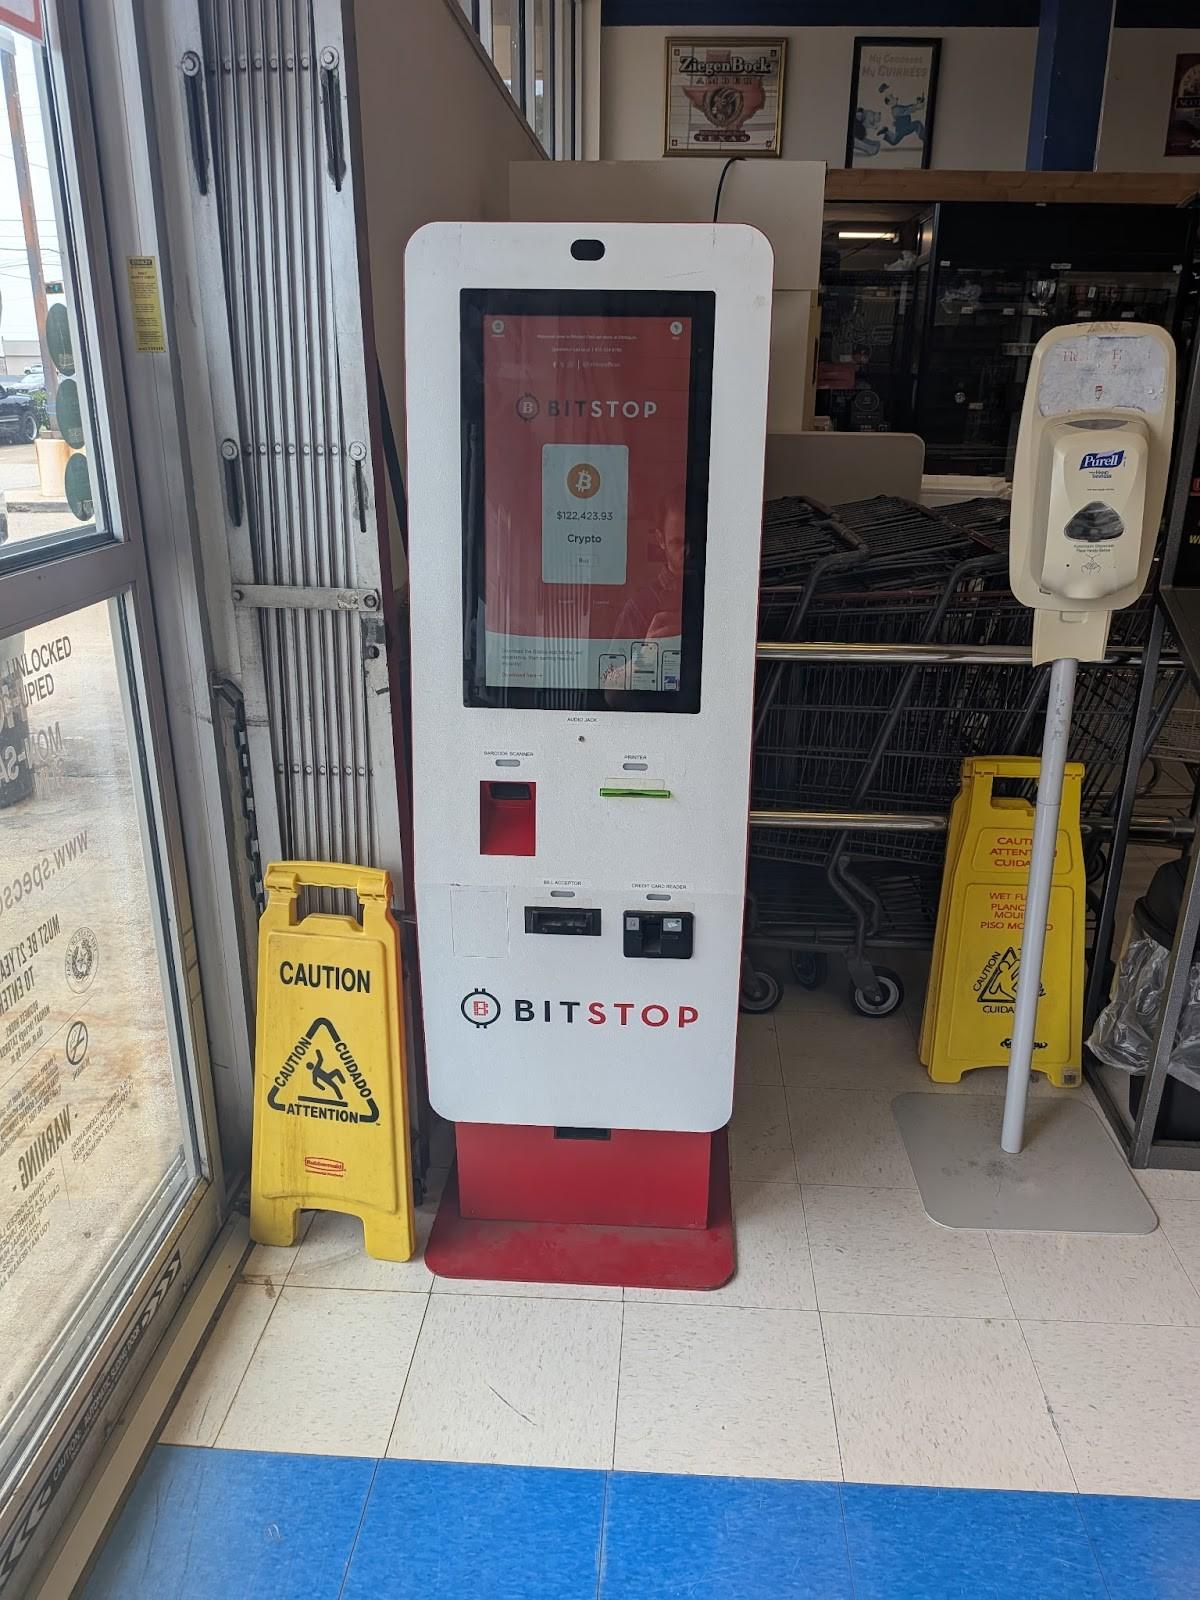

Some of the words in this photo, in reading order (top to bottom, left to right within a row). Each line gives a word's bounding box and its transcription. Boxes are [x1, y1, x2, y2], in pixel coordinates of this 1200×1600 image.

[680, 56, 771, 76] ZiegenBock
[549, 400, 657, 418] BITSTOP
[1084, 454, 1119, 468] Purell
[557, 511, 613, 521] $122,423.93
[567, 534, 602, 545] Crypto
[6, 635, 72, 678] UNLOCKED
[997, 838, 1033, 846] CAUTI
[994, 859, 1031, 867] CUIDA
[990, 892, 1012, 900] WET
[991, 904, 1025, 912] PLANC
[995, 911, 1025, 919] MOUI
[980, 921, 1004, 930] PISO
[280, 960, 371, 993] CAUTION
[972, 951, 1002, 992] CAUTION
[514, 999, 699, 1028] BITSTOP
[982, 1005, 1015, 1014] CUIDA
[274, 1036, 313, 1088] CAUTION
[334, 1041, 373, 1099] CUIDADO
[286, 1104, 359, 1124] ATTENTION
